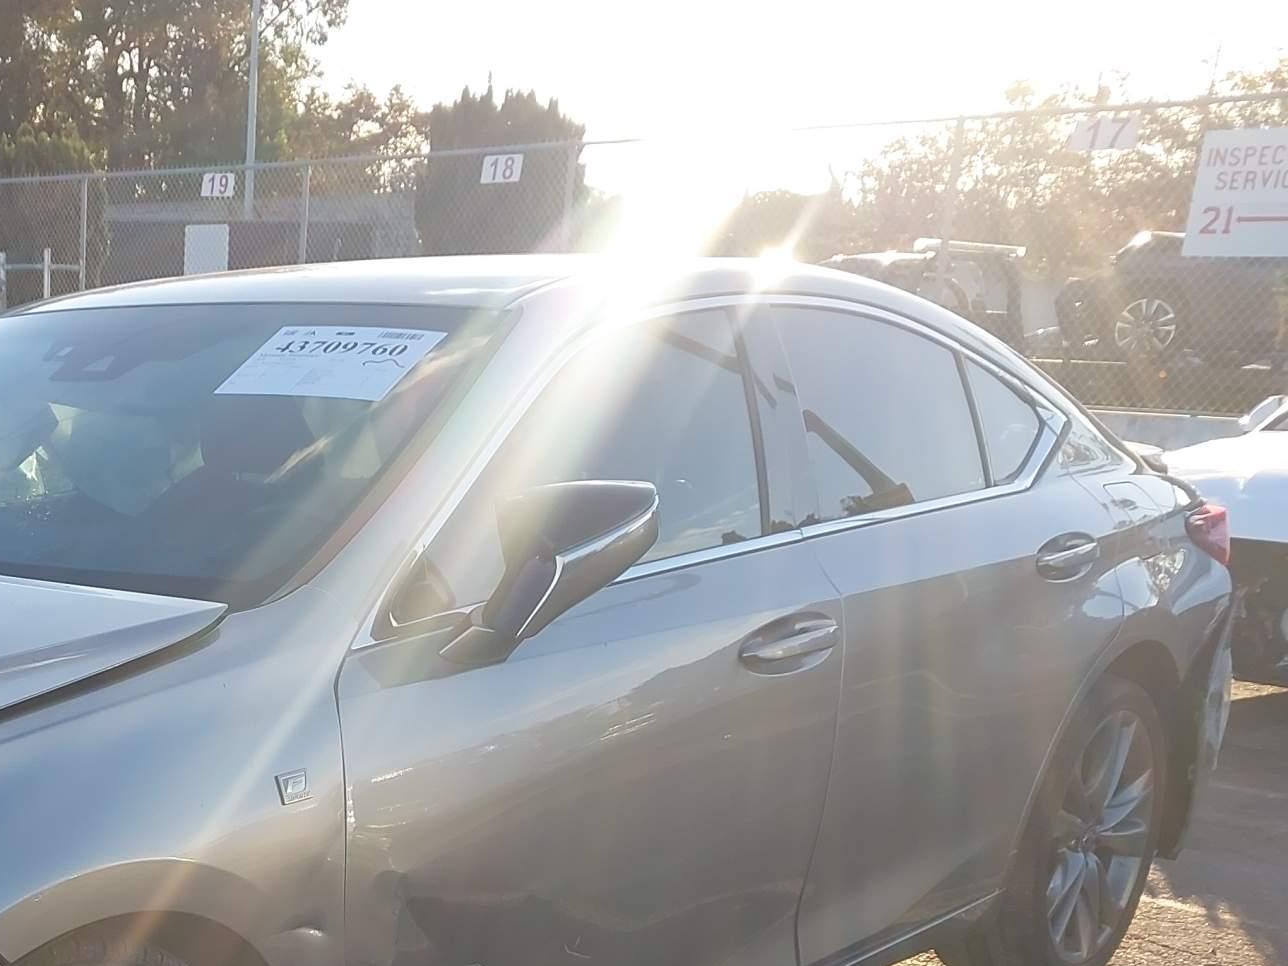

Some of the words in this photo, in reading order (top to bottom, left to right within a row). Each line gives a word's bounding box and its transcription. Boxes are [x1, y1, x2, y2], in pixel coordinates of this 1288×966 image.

[1087, 116, 1132, 150] 17
[1206, 145, 1287, 167] INSPEC
[490, 156, 515, 181] 18
[208, 174, 229, 195] 19
[1199, 205, 1234, 235] 21
[275, 340, 409, 357] 43709760
